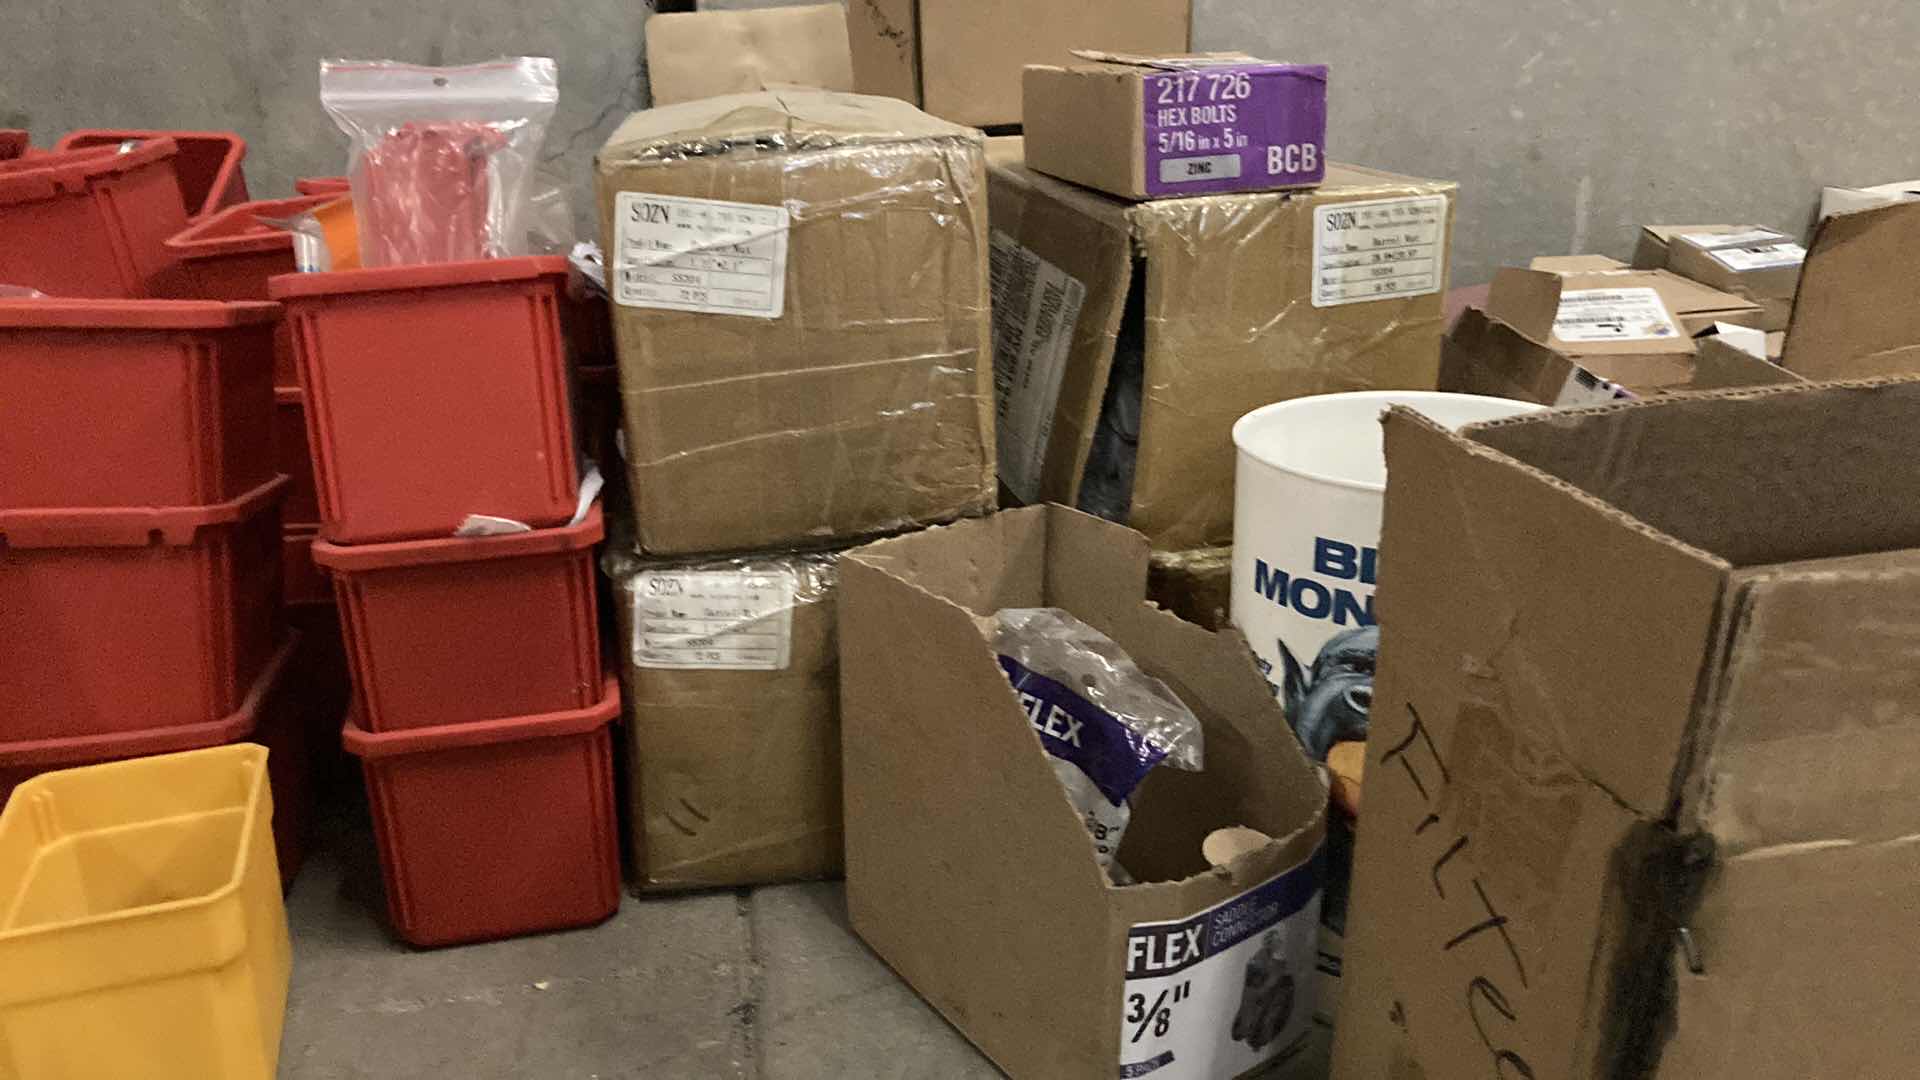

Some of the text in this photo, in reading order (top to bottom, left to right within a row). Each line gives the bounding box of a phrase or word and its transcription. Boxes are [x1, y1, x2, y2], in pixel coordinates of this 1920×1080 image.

[1157, 72, 1251, 104] 217 726
[1157, 104, 1238, 127] HEX BOLTS
[1158, 131, 1197, 153] 5/16
[1212, 137, 1220, 149] x
[1223, 128, 1234, 149] 5
[1187, 161, 1212, 176] ZINC
[1267, 143, 1318, 175] BCB
[1126, 923, 1203, 973] FLEX
[1127, 979, 1192, 1044] 3/8"
